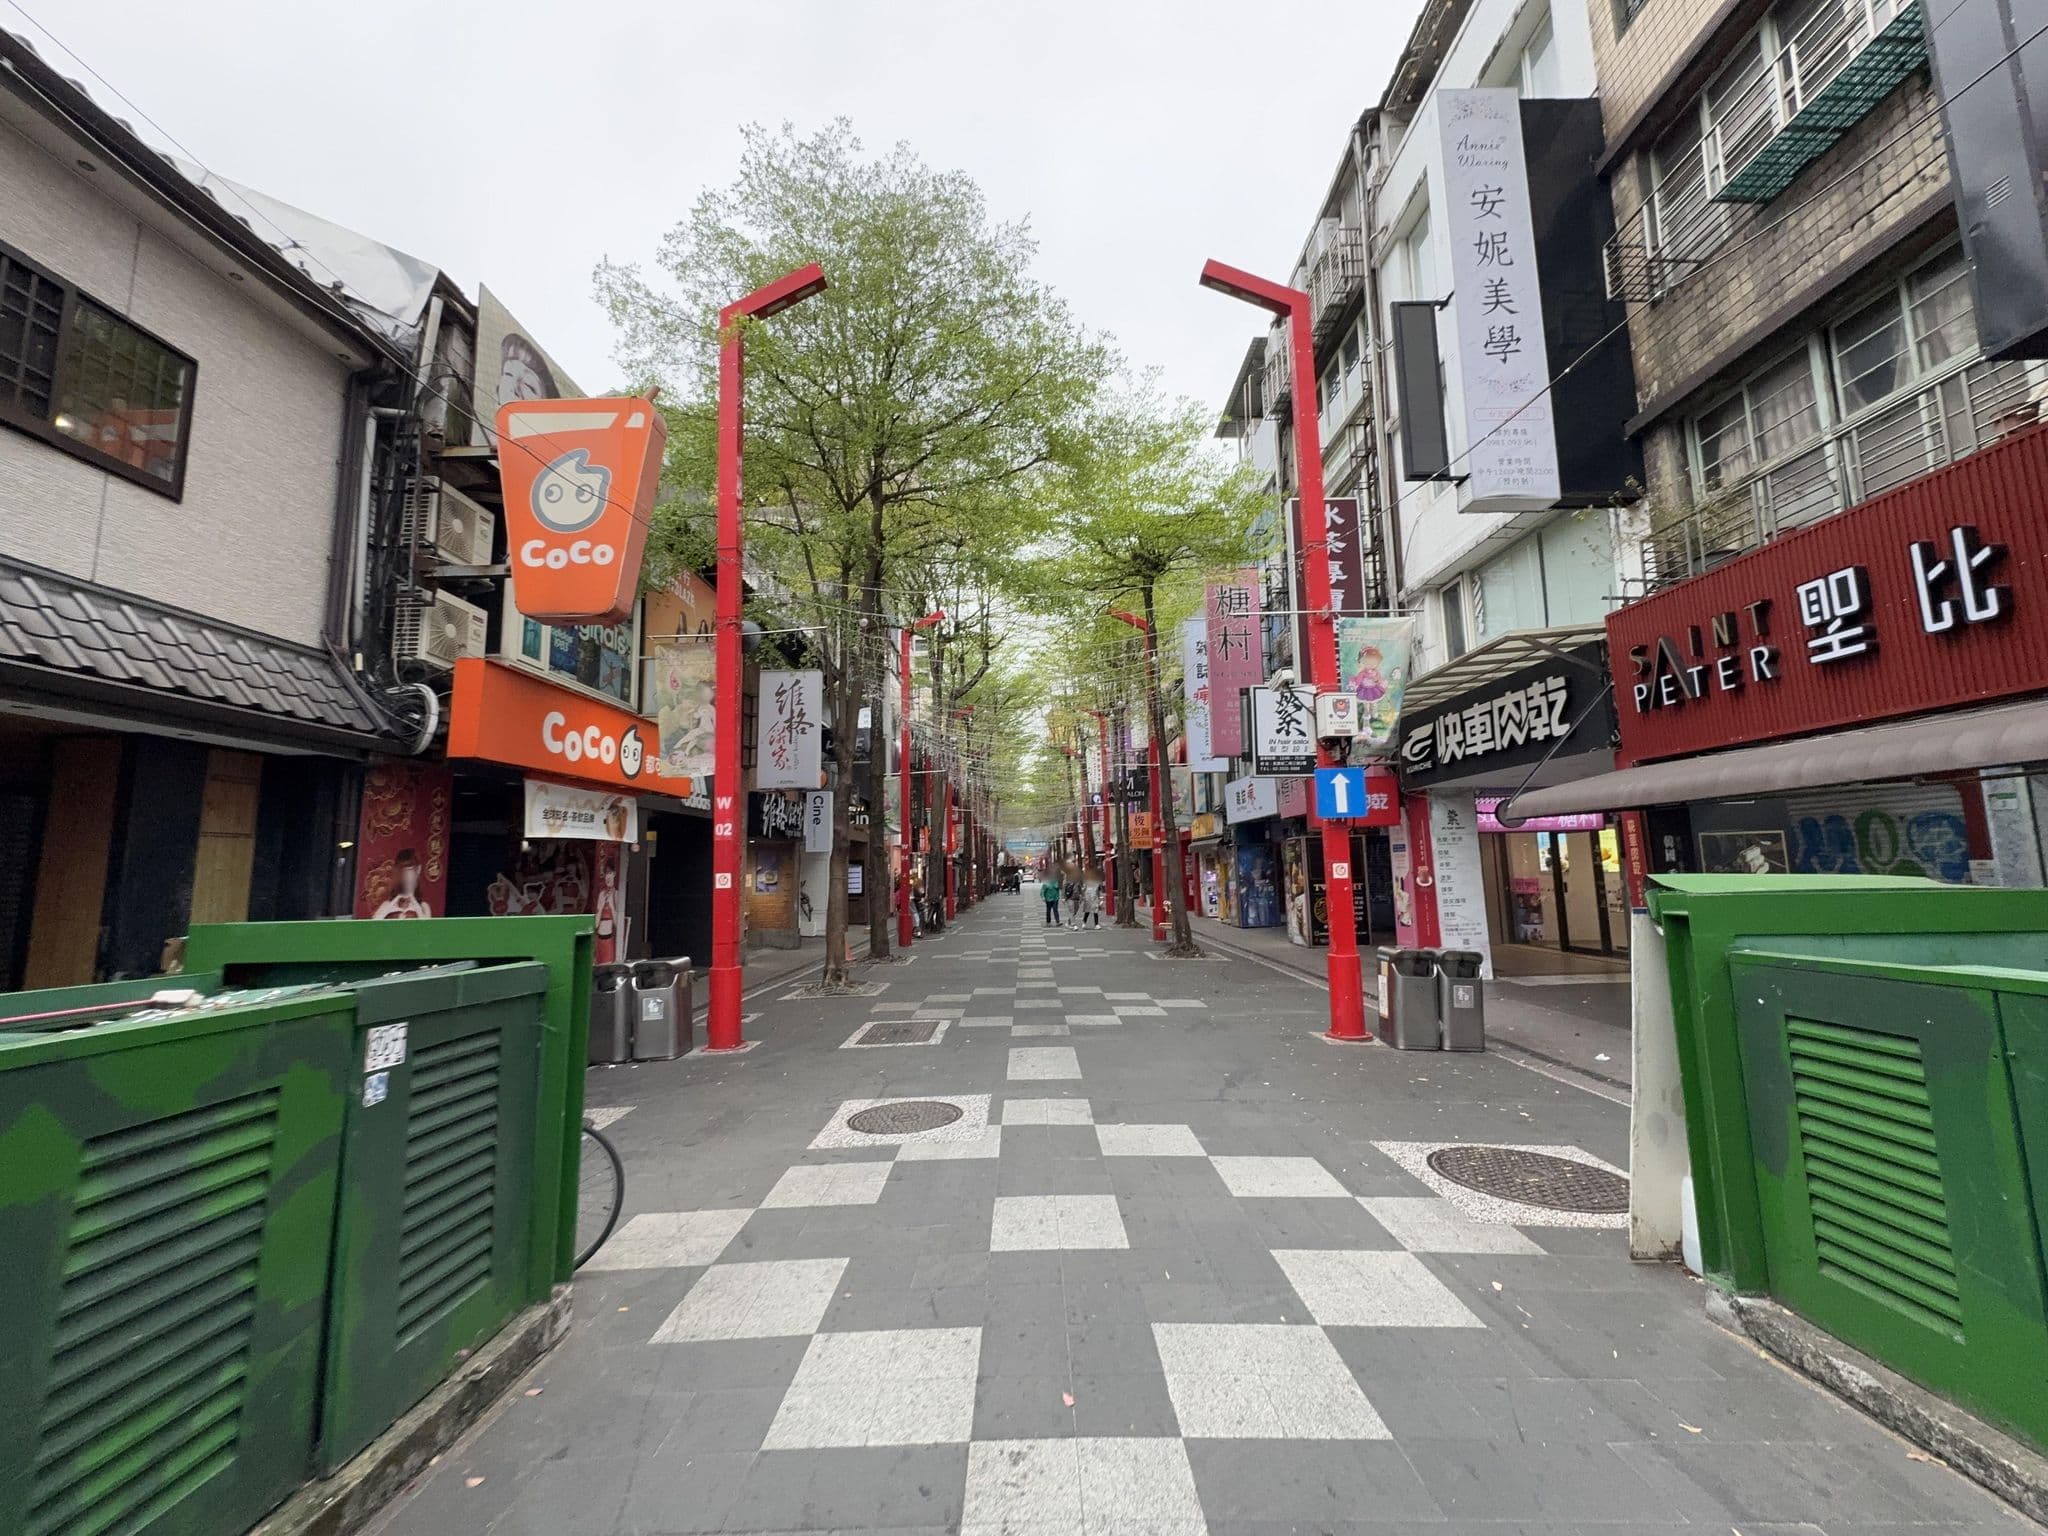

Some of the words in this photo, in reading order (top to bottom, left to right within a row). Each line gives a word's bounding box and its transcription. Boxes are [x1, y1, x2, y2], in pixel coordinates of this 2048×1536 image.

[1457, 134, 1502, 151] Annie
[1470, 184, 1522, 364] 安妮美學
[520, 540, 615, 569] CoCo
[1214, 584, 1252, 662] 糖村
[1629, 600, 1771, 709] SAINT
[1633, 645, 1773, 713] PETER
[542, 711, 617, 764] CoCo
[1436, 676, 1571, 764] 快車肉乾
[715, 823, 733, 836] 02
[716, 797, 732, 809] W
[812, 795, 825, 826] Cine
